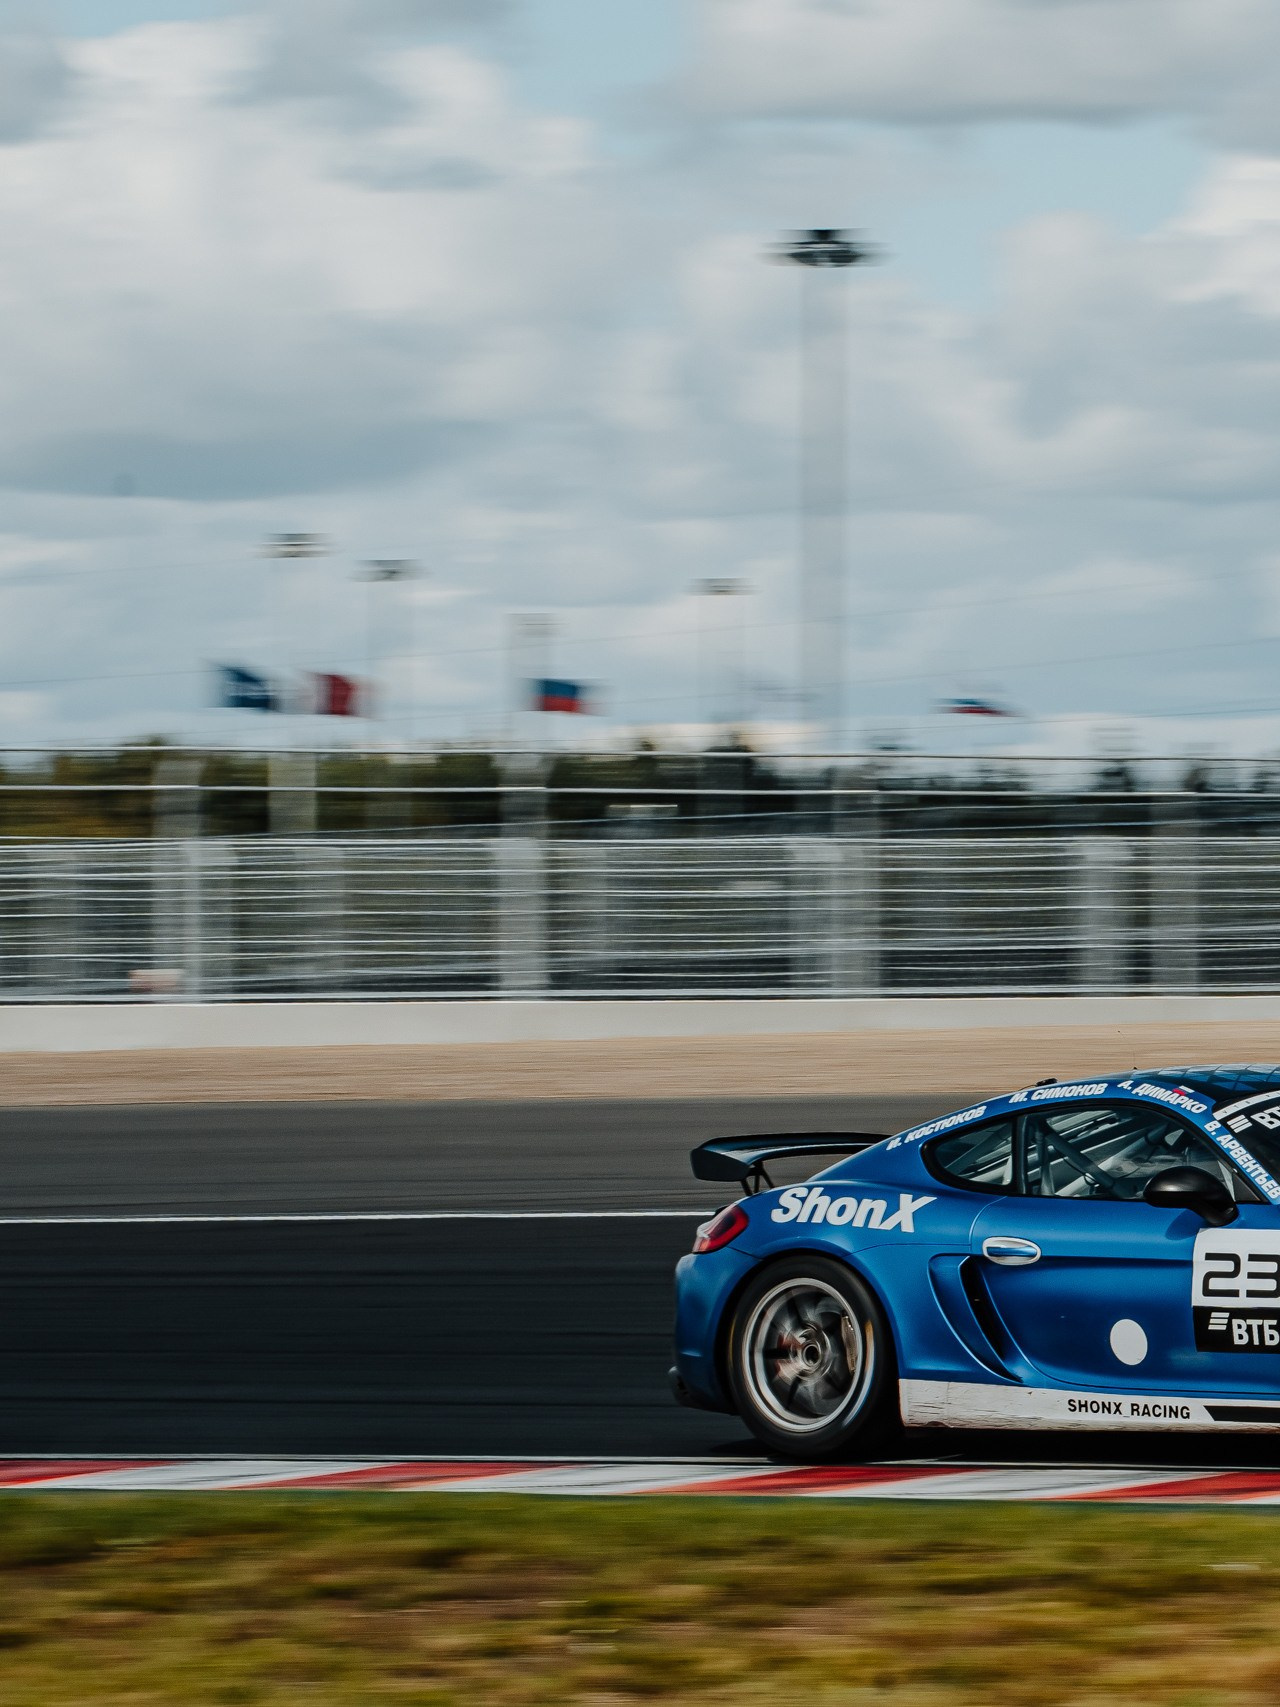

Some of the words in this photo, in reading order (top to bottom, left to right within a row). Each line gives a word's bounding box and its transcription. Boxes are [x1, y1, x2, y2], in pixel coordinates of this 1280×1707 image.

[1031, 1083, 1109, 1100] СИМОНОВ
[1117, 1080, 1132, 1091] А.
[1131, 1083, 1208, 1114] ДИМАРКО
[903, 1105, 988, 1143] КОСТЮКОВ
[1204, 1120, 1221, 1136] В.
[771, 1187, 938, 1233] ShonX
[1231, 1318, 1280, 1346] ВТБ
